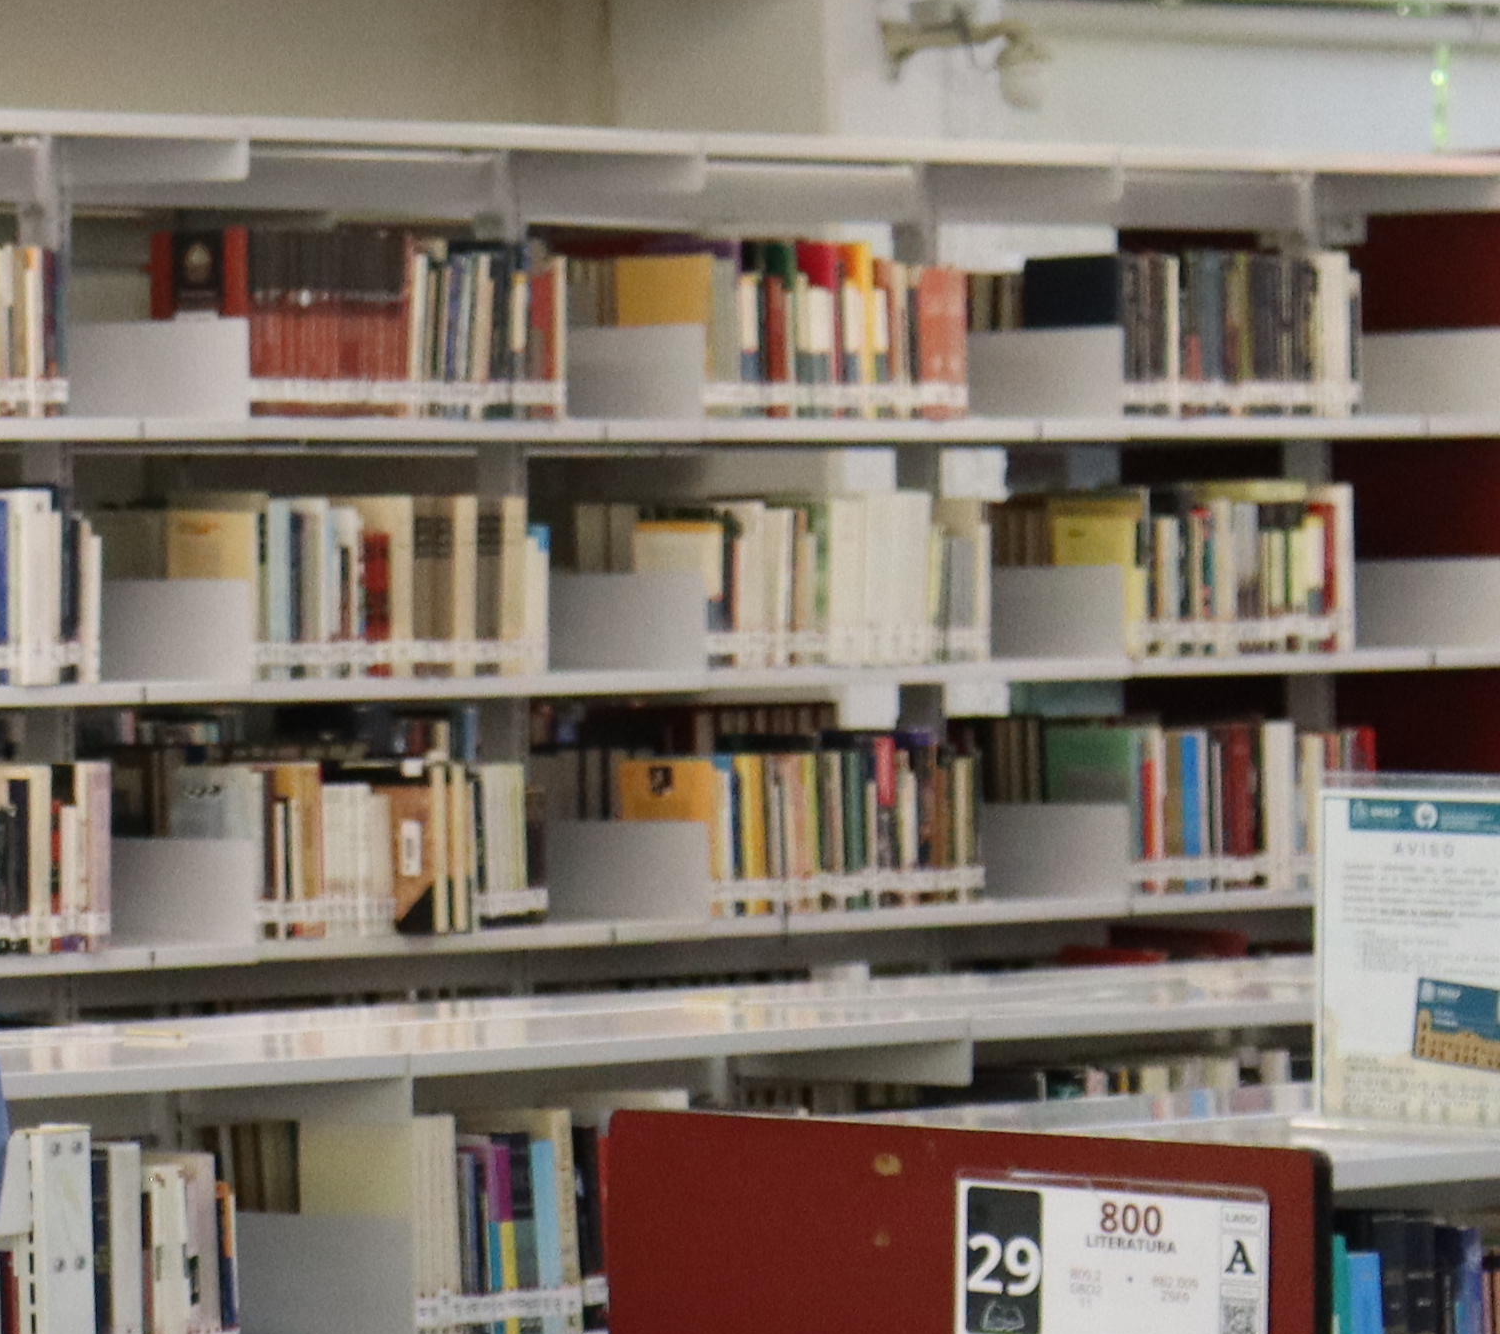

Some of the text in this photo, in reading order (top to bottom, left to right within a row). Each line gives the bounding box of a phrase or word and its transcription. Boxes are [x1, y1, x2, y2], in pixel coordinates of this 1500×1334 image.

[1394, 842, 1456, 858] AVISO
[1099, 1201, 1164, 1238] 800
[1086, 1235, 1177, 1256] LITERATURA
[1224, 1239, 1257, 1276] A
[966, 1232, 1043, 1298] 29
